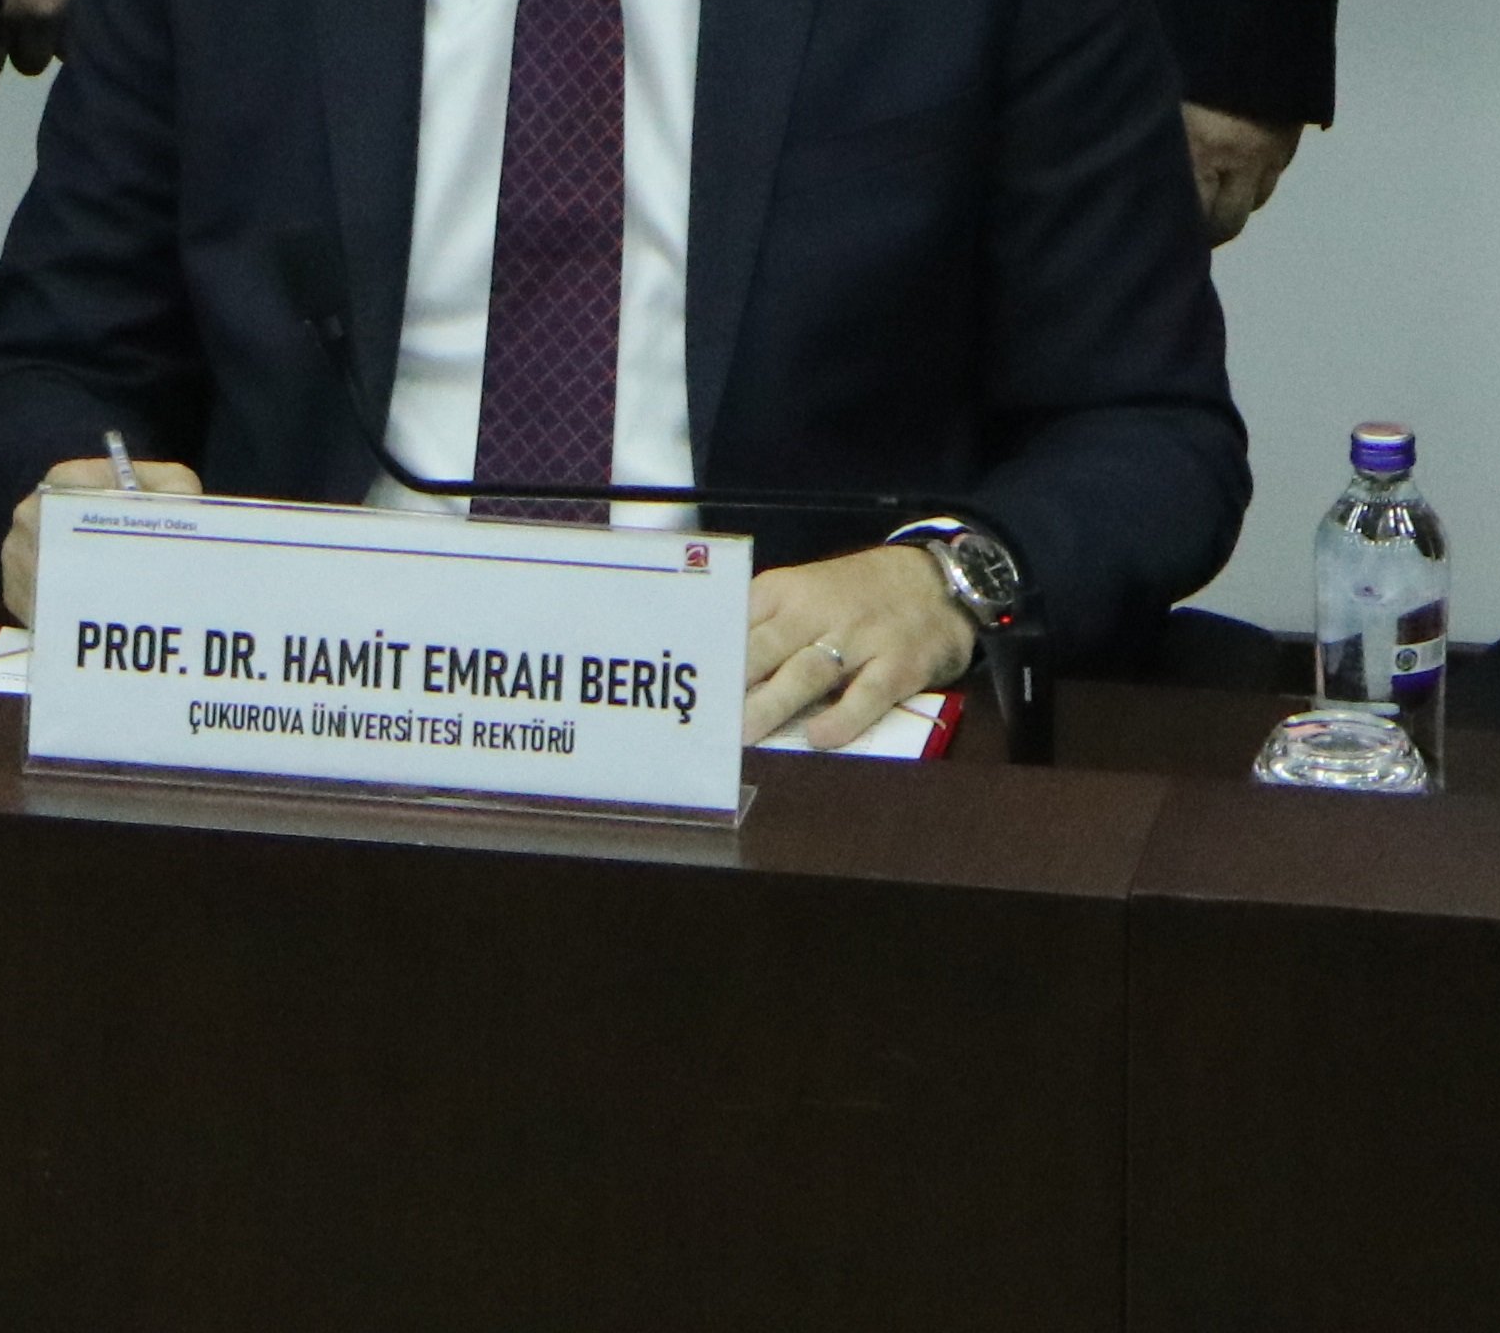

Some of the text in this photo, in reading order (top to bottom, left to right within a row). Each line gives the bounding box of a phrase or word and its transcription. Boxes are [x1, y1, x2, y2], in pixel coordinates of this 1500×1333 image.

[76, 620, 698, 725] PROF. DR. HAMİT EMRAH BERİŞ
[188, 700, 576, 755] ÇUKUROVA ÜNİVERSİTESİ REKTÖRÜ
